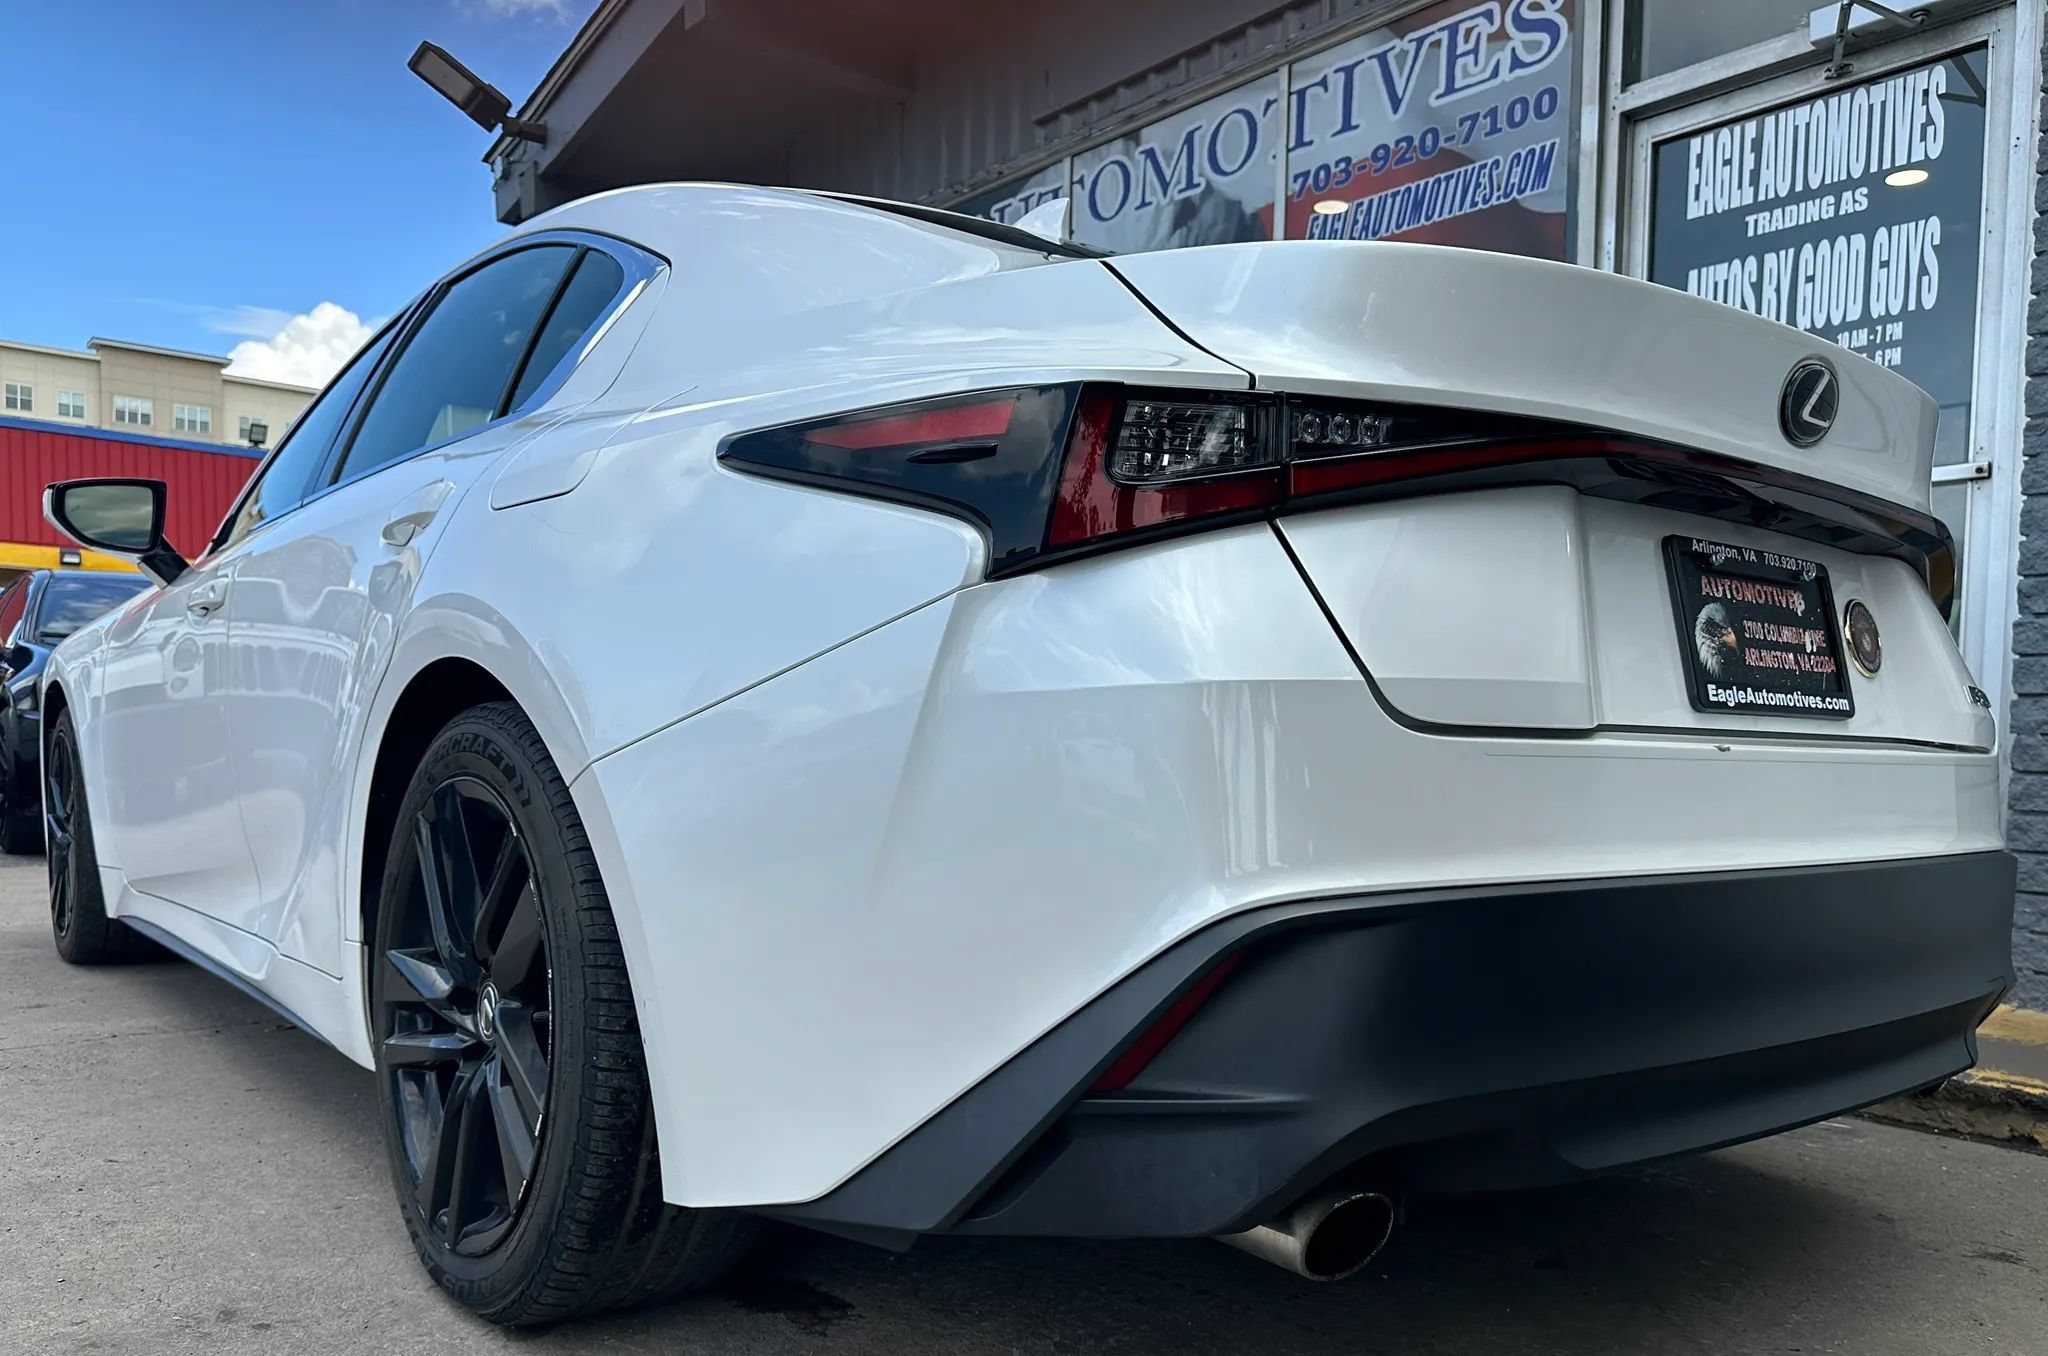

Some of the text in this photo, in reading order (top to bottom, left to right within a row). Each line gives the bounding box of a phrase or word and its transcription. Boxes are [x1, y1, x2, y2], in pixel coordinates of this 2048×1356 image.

[991, 0, 1566, 232] OMOTIVES
[1292, 86, 1559, 201] 703-920-7100
[1686, 65, 1947, 220] EAGLE AUTOMOTIVES
[1745, 187, 1869, 238] TRADING AS
[1761, 247, 1795, 327] BY
[1796, 232, 1867, 331] GOOD
[1869, 215, 1941, 319] GUYS
[1850, 328, 1868, 349] AM
[1875, 325, 1883, 344] 7
[1885, 321, 1903, 342] PM
[1884, 346, 1902, 367] PM
[1692, 539, 1741, 561] Arlington,
[1742, 548, 1757, 563] VA
[1803, 628, 1827, 648] IKE
[1706, 683, 1850, 711] EagleAutomotives.com
